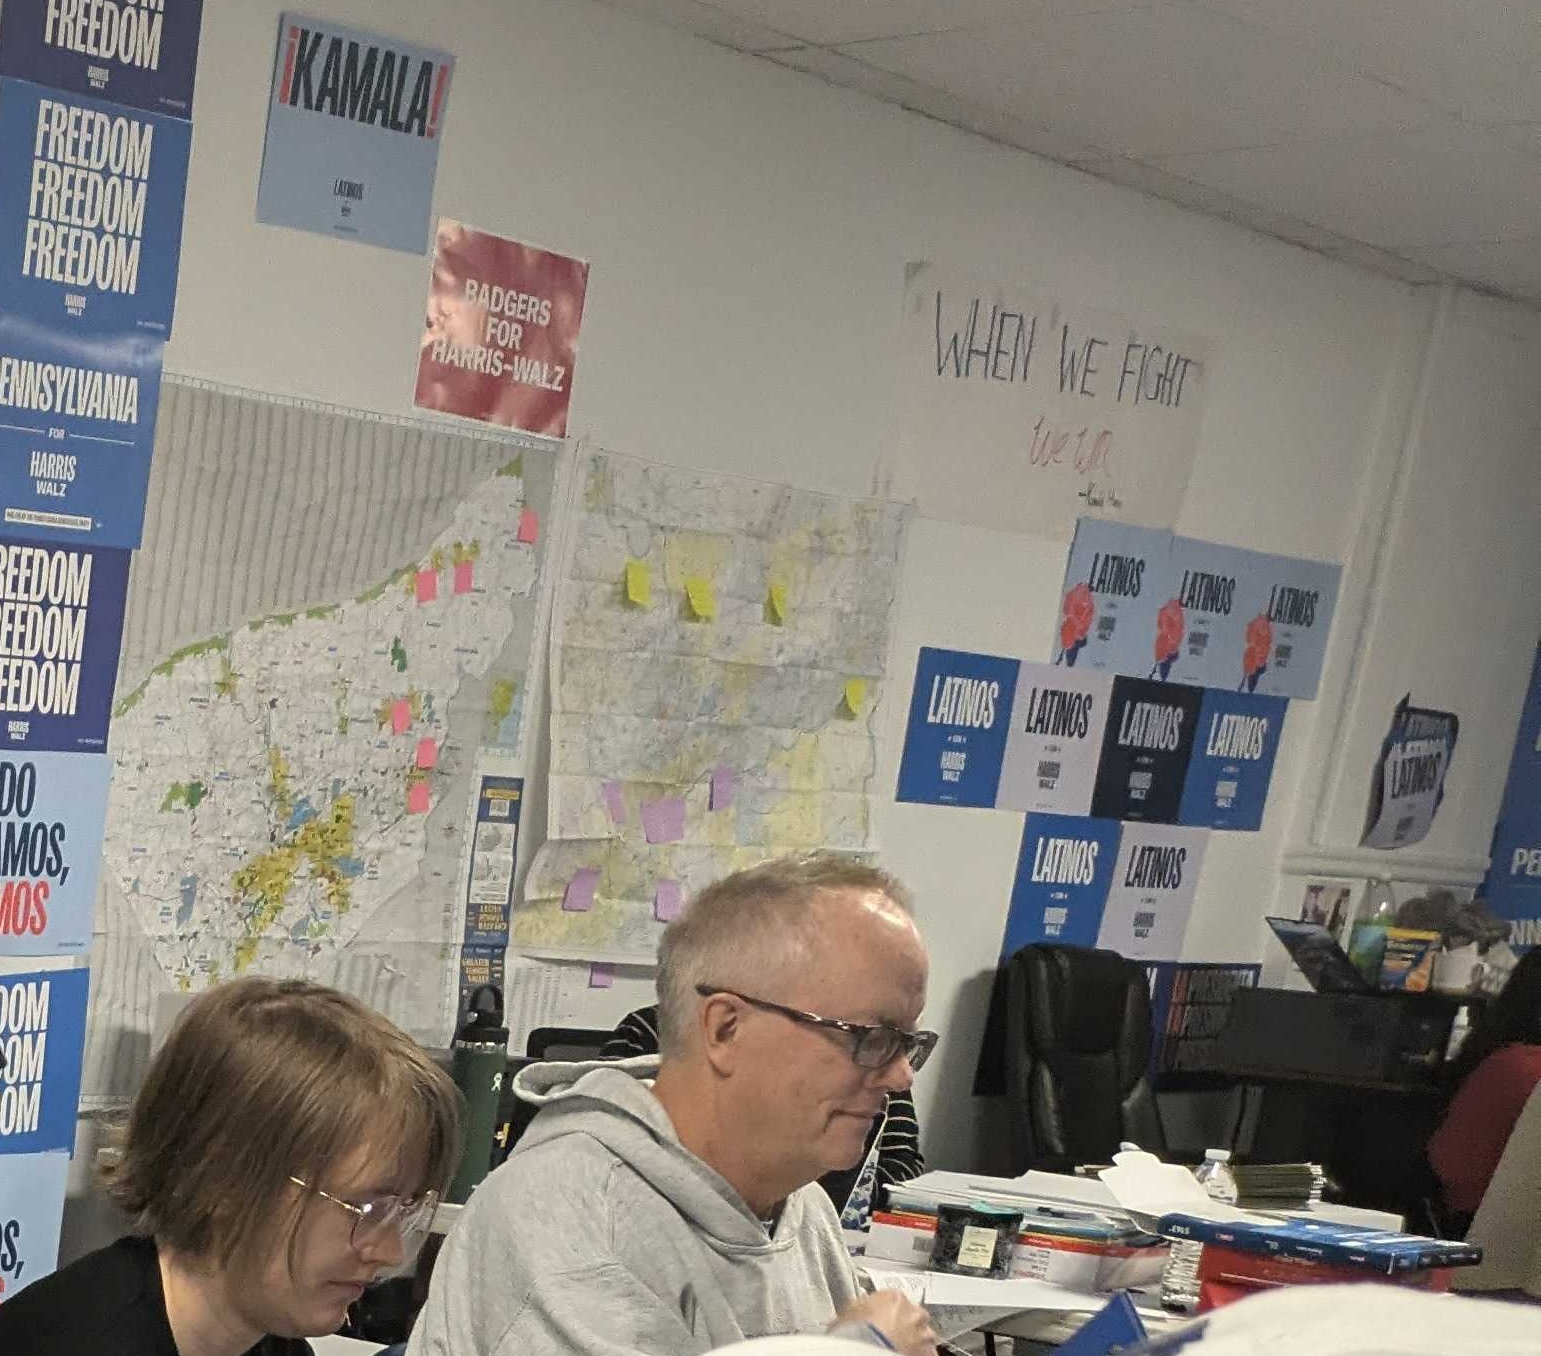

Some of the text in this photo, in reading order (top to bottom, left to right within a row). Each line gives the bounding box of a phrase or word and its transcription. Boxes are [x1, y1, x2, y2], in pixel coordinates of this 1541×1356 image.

[34, 99, 154, 180] FREEDOM
[29, 159, 148, 238] FREEDOM
[22, 218, 141, 295] FREEDOM
[465, 279, 551, 326] BADGERS
[486, 319, 523, 349] FOR
[935, 290, 1196, 408] WHEN WE FIGHT
[431, 340, 565, 392] HARRIS-WALZ
[49, 427, 65, 441] FOR
[30, 450, 77, 482] HARRIS
[36, 482, 66, 498] WALZ
[1088, 552, 1145, 598] LATINOS
[1179, 570, 1236, 616] LATINOS
[1268, 584, 1319, 628] LATINOS
[927, 674, 999, 730] LATINOS
[1025, 687, 1092, 740] LATINOS
[1118, 700, 1184, 751] LATINOS
[1205, 712, 1269, 761] LATINOS
[1031, 837, 1099, 886] LATINOS
[1125, 845, 1186, 889] LATINOS
